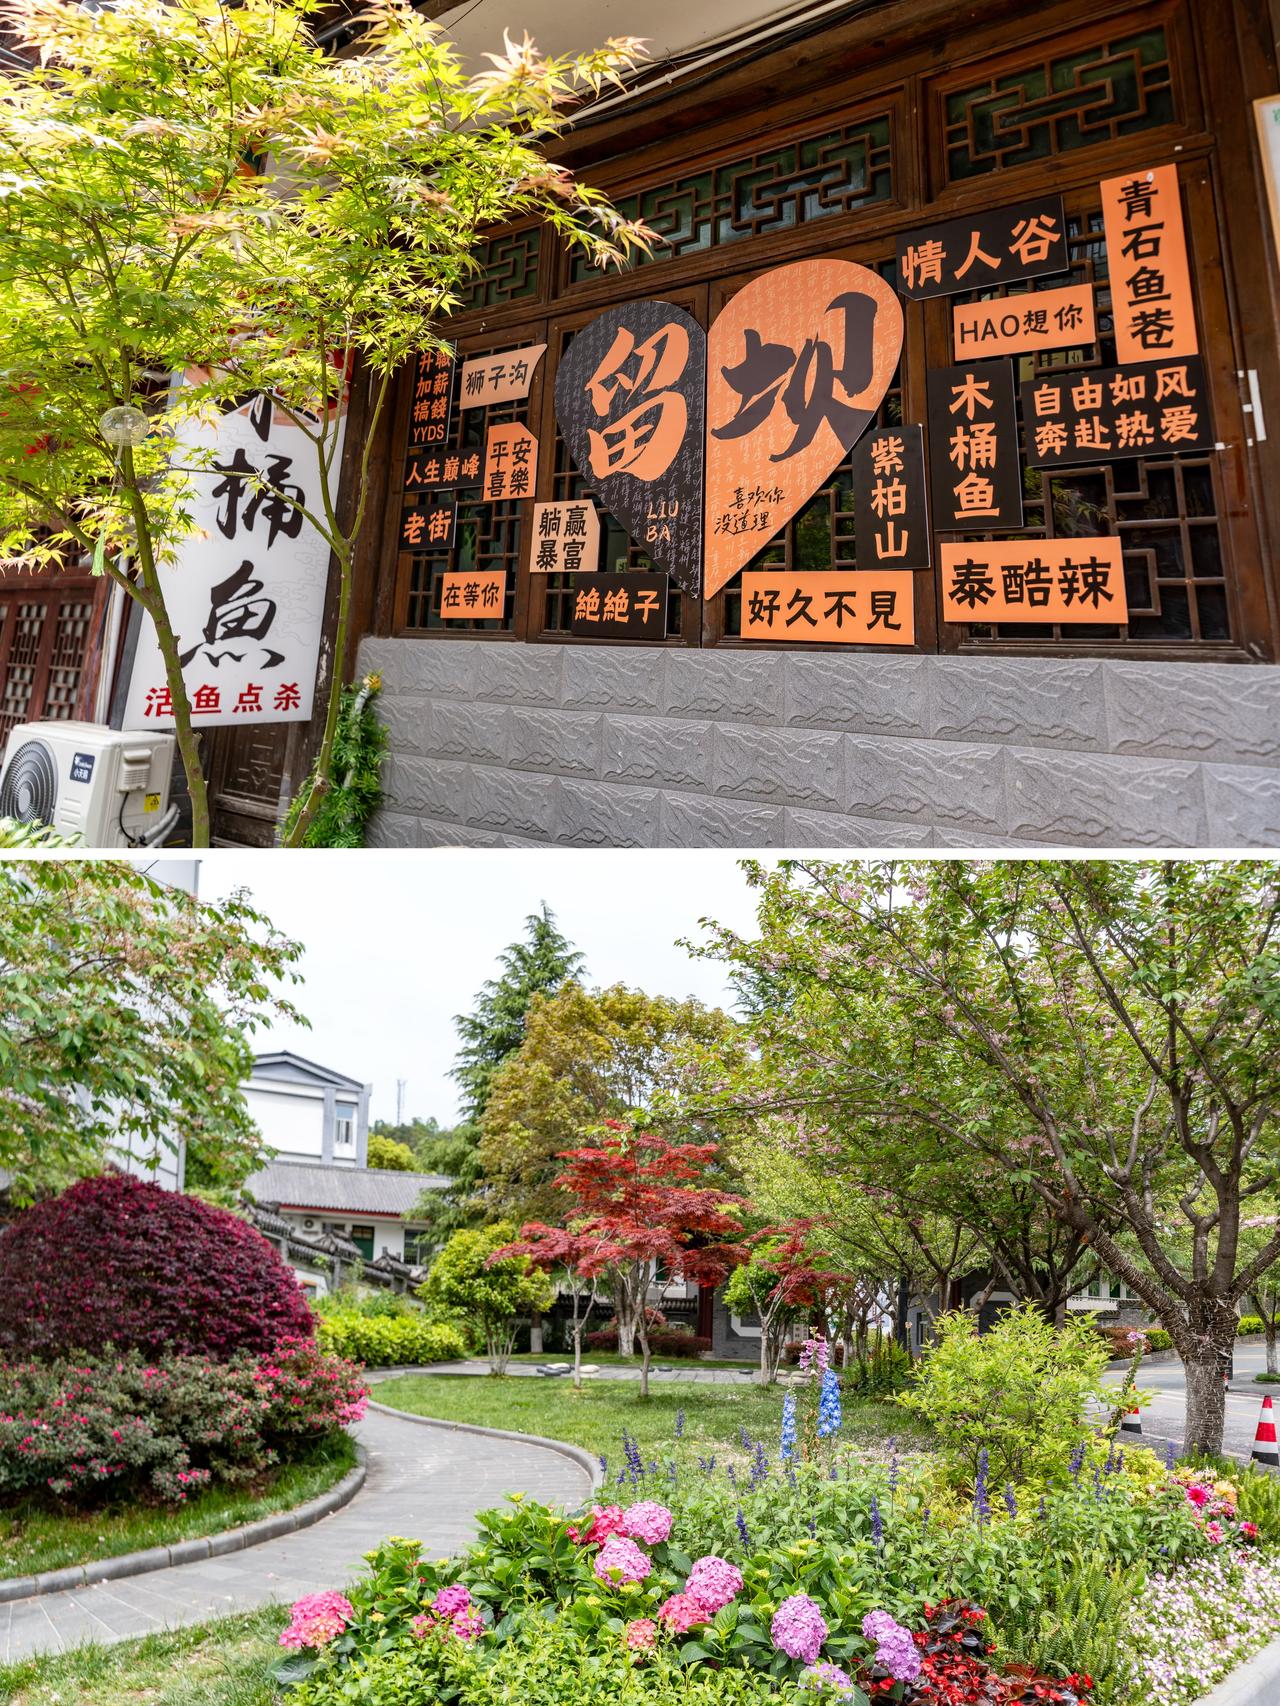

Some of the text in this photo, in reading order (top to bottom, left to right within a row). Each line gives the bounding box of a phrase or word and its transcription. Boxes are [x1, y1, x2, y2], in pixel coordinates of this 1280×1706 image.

[902, 214, 1061, 290] 情人谷
[960, 303, 1083, 344] HAO想你
[417, 372, 449, 396] 加薪
[466, 362, 529, 395] 狮子沟
[1034, 367, 1197, 418] 自由如风
[414, 397, 447, 421] 搞錢
[413, 424, 445, 442] YYDS
[949, 374, 1000, 520] 木桶鱼
[1034, 405, 1199, 459] 奔赴热爱
[406, 453, 480, 486] 人生巅峰
[491, 438, 532, 468] 平安
[488, 468, 529, 498] 喜樂
[729, 486, 785, 509] 喜欢你
[871, 437, 909, 560] 紫柏山
[539, 504, 588, 538] 躺赢
[646, 500, 679, 519] LIU
[714, 509, 770, 536] 没道理
[404, 509, 451, 544] 老街
[646, 525, 671, 542] BA
[536, 538, 586, 571] 暴富
[444, 582, 499, 608] 在等你
[949, 556, 1114, 609] 泰酷辣
[748, 589, 902, 631] 好久不見
[144, 683, 301, 718] 活鱼点杀
